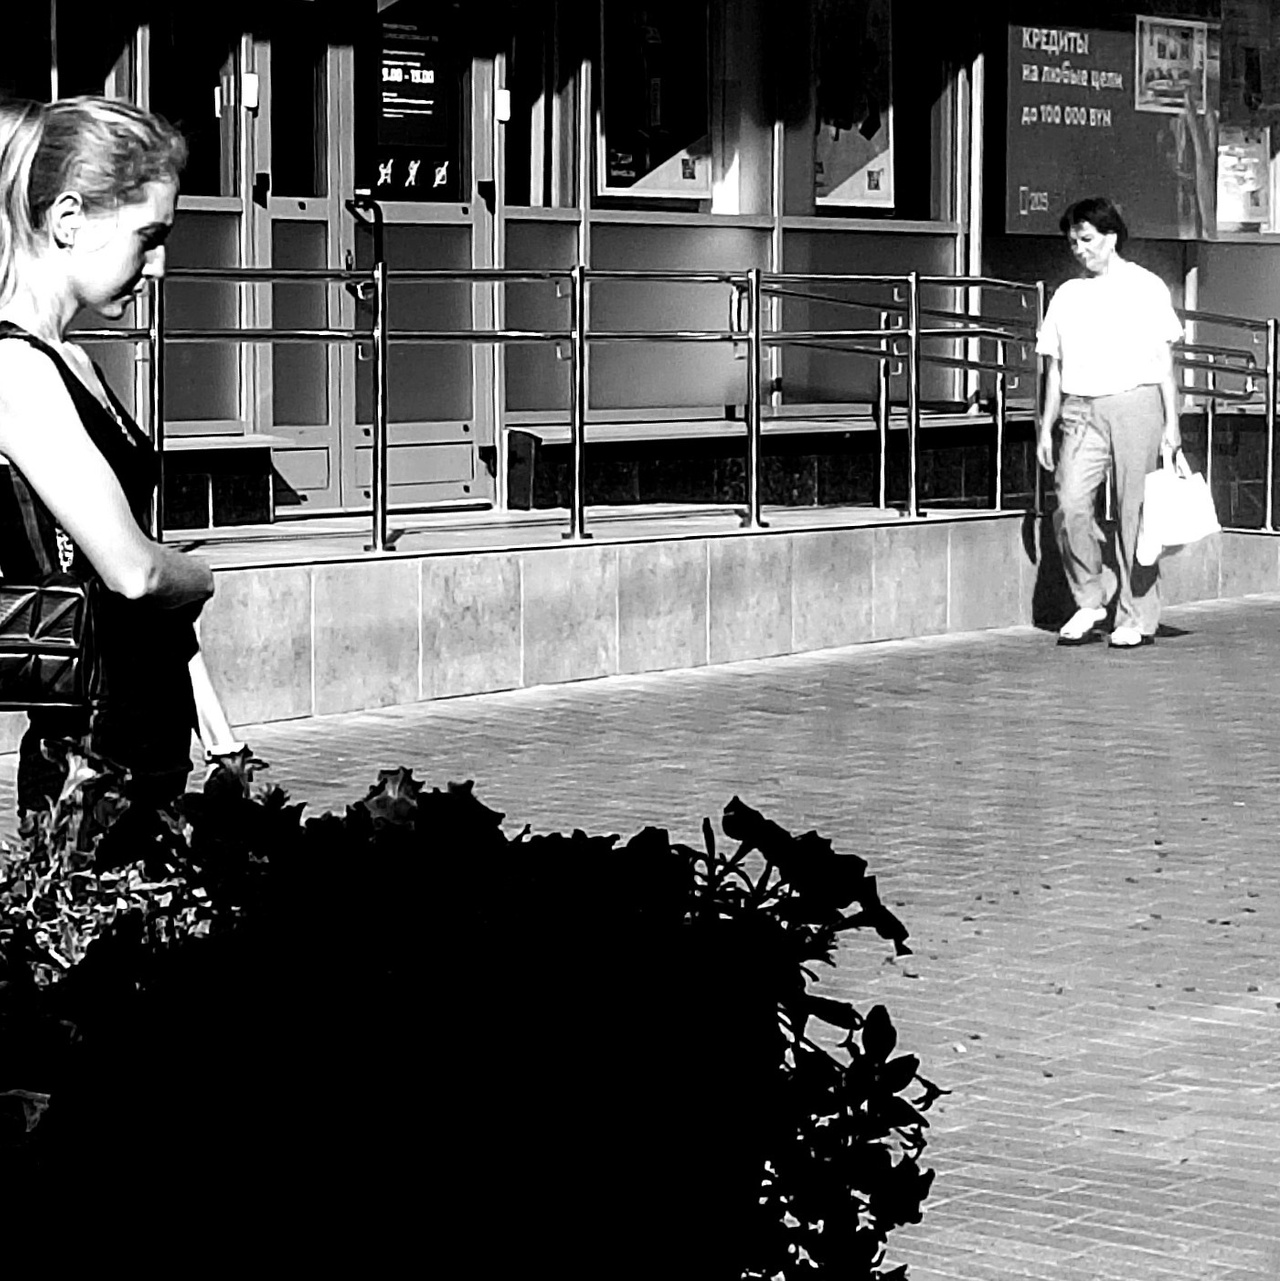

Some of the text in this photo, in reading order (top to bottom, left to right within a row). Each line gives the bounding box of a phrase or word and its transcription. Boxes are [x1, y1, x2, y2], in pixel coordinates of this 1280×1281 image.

[1022, 26, 1090, 56] КРЕДИТЫ
[1022, 60, 1124, 90] на любые цели
[1021, 106, 1038, 125] до
[1040, 104, 1061, 124] 100
[1064, 106, 1087, 125] 000
